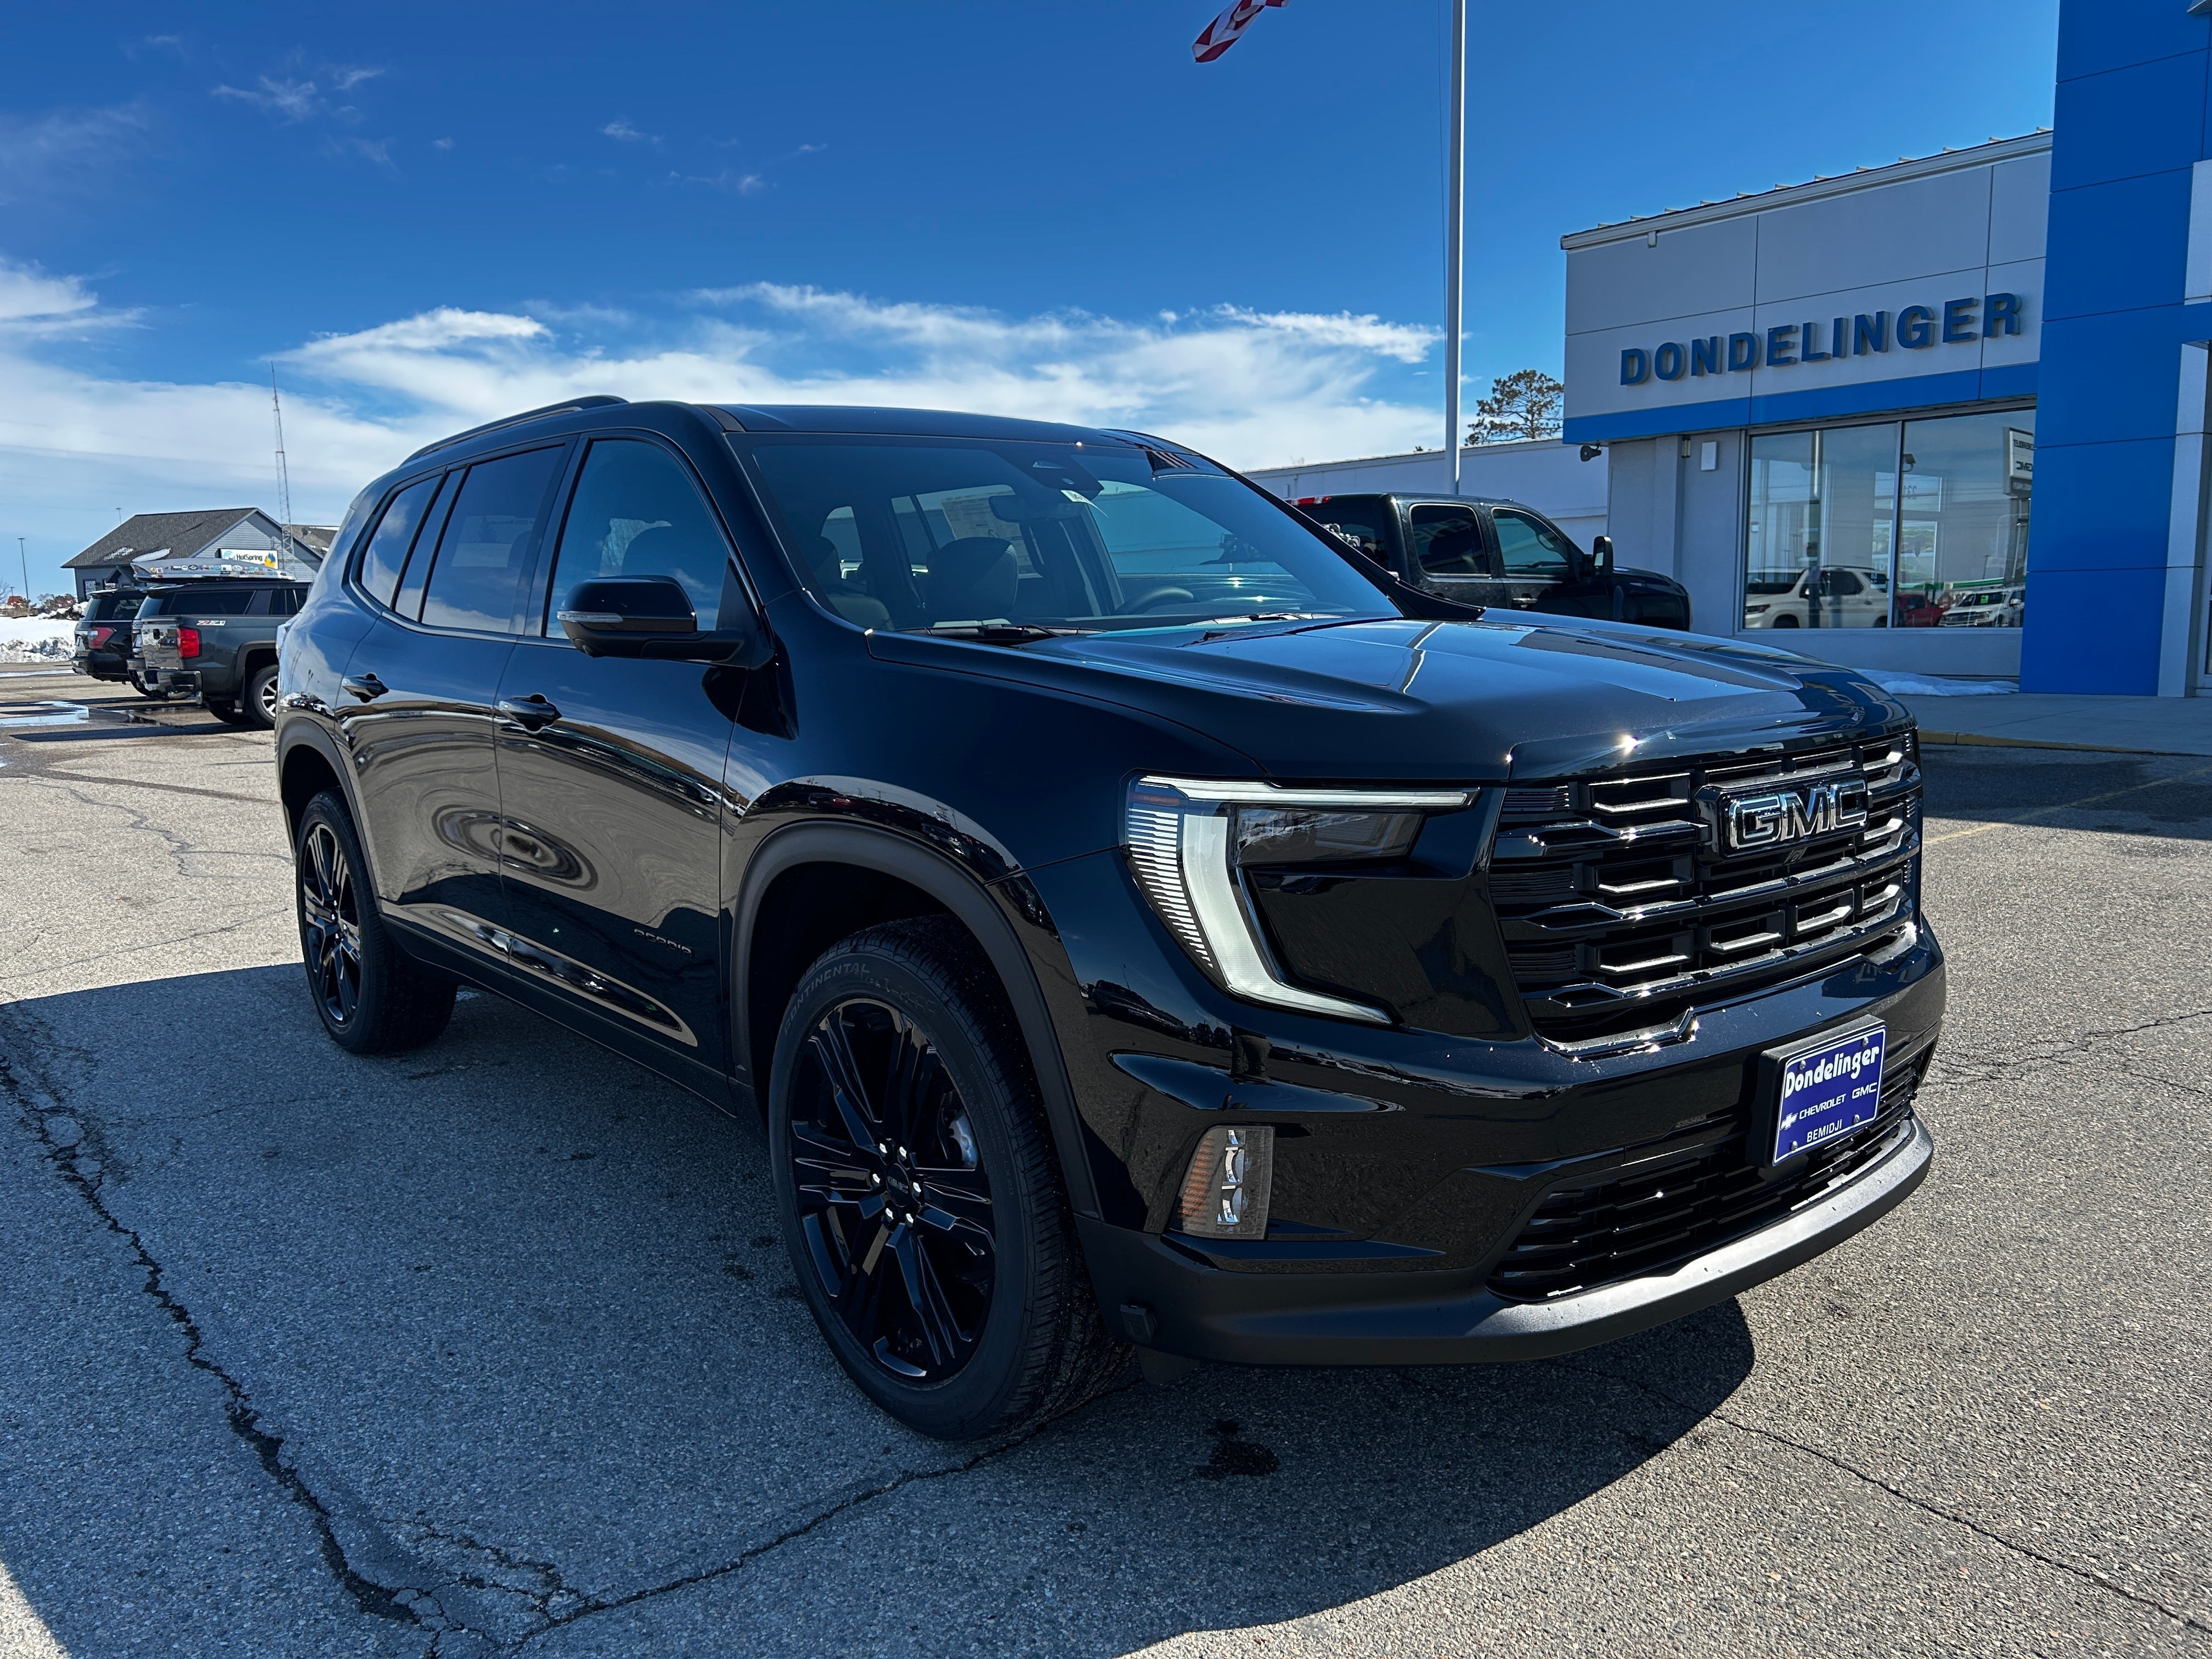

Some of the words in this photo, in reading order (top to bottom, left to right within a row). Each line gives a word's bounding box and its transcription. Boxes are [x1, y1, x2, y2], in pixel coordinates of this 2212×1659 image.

[1621, 292, 2023, 386] DONDELINGER
[236, 554, 263, 562] HotSpring
[1730, 778, 1869, 848] GMC
[785, 962, 871, 1035] CONTINENTAL
[1785, 1046, 1880, 1098] Dondelinger
[1799, 1093, 1847, 1120] CHEVROLET
[1852, 1082, 1877, 1098] GMC
[1807, 1119, 1843, 1142] BEMIDJI
[887, 1176, 909, 1194] GMC
